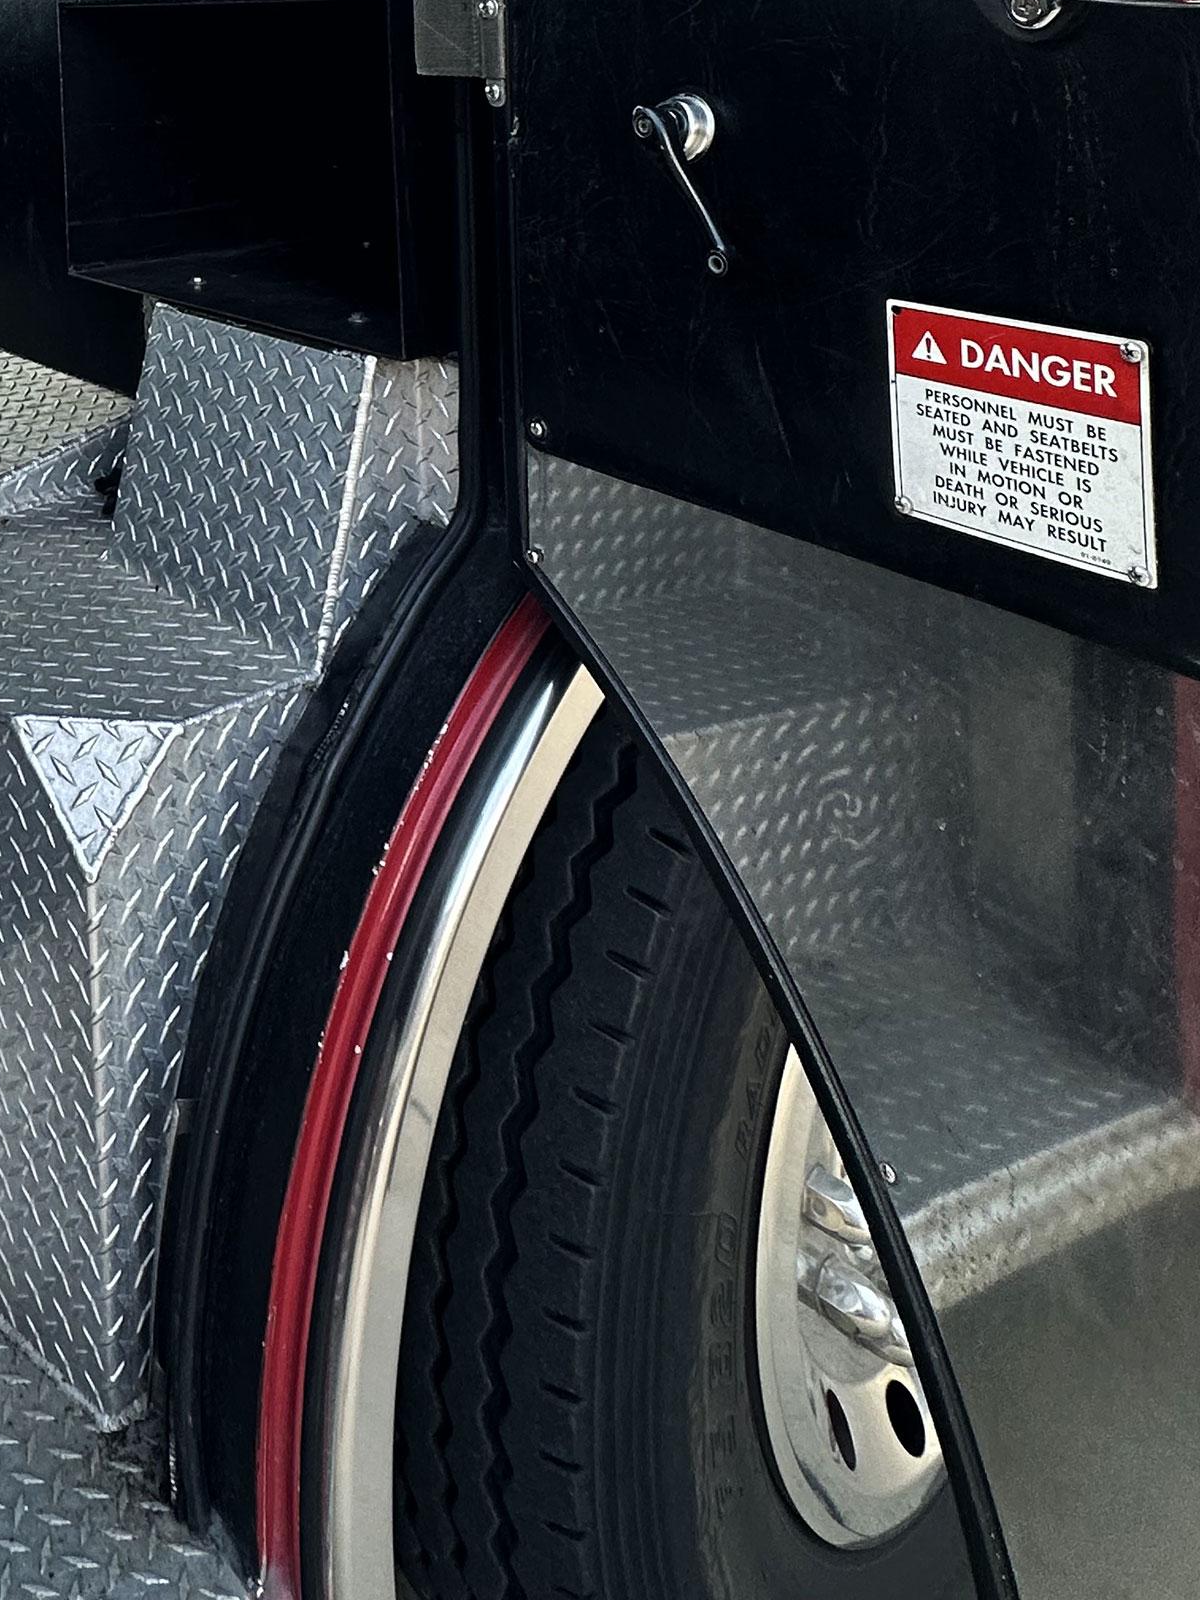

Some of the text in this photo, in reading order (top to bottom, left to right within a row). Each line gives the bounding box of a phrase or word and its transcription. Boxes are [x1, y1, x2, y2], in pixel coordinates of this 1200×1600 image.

[960, 338, 1118, 398] DANGER
[916, 404, 1118, 462] SEATED AND SEATBELTS
[925, 388, 1106, 441] PERSONNEL MUST BE
[932, 424, 1099, 476] MUST BE FASTENED
[940, 443, 1092, 492] WHILE VEHICLE IS
[935, 476, 1103, 532] DEATH OR SERIOUS
[950, 462, 1083, 509] IN MOTION OR
[933, 491, 1107, 552] INJURY MAY RESULT
